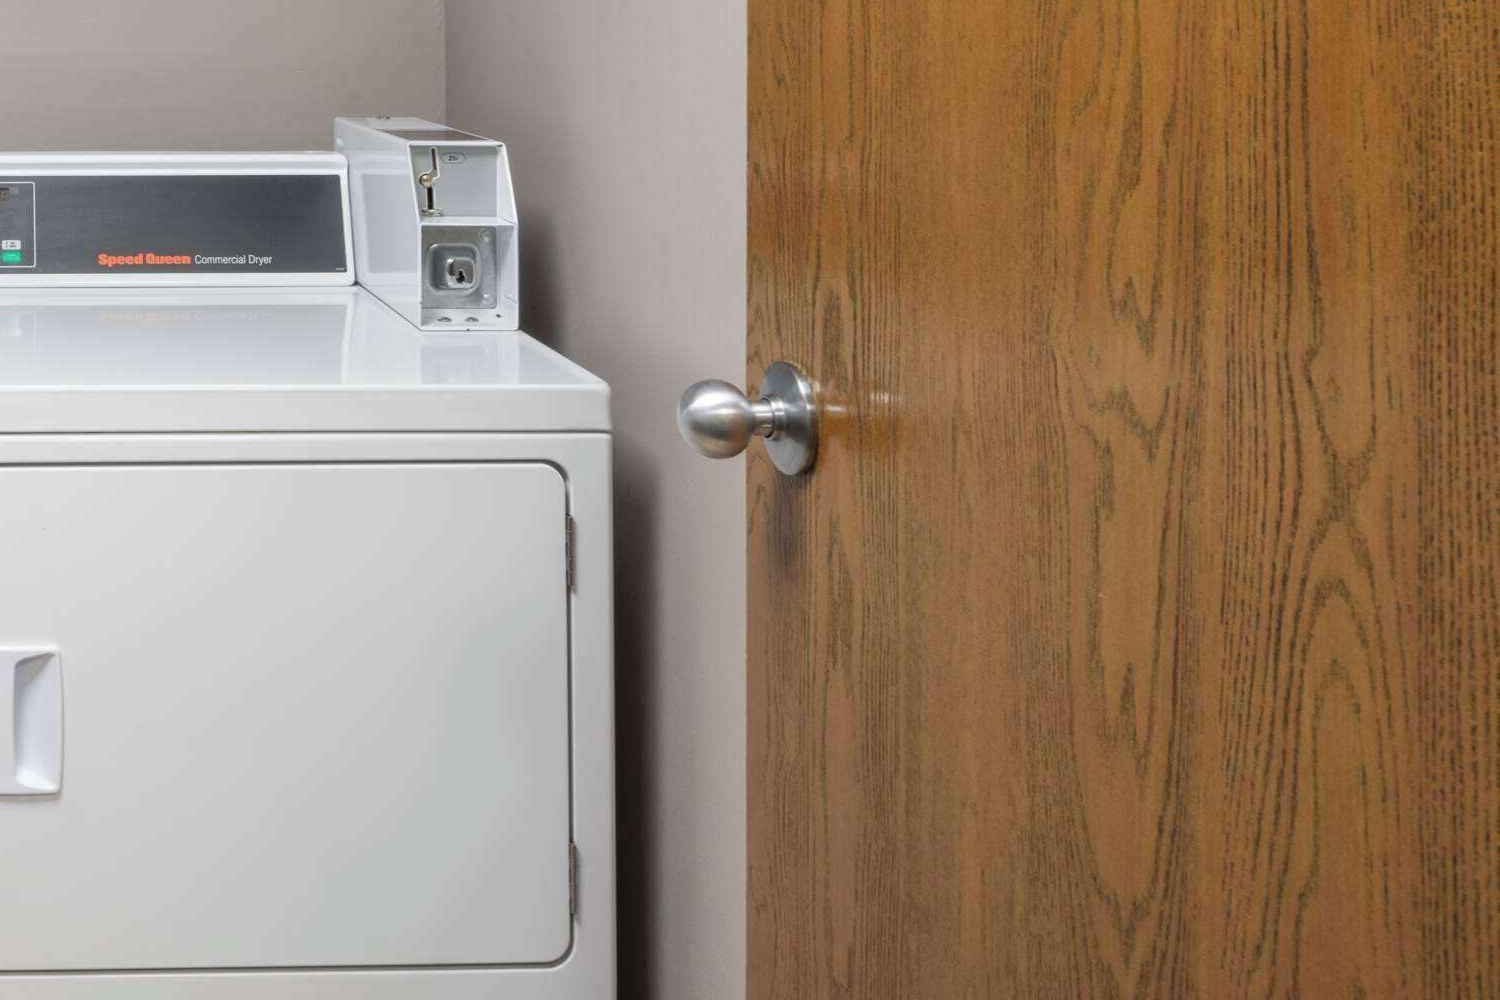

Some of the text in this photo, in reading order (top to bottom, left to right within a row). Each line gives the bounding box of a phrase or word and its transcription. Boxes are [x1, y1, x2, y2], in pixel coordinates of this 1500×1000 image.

[98, 253, 273, 268] Speed Queen Commercial Dryer
